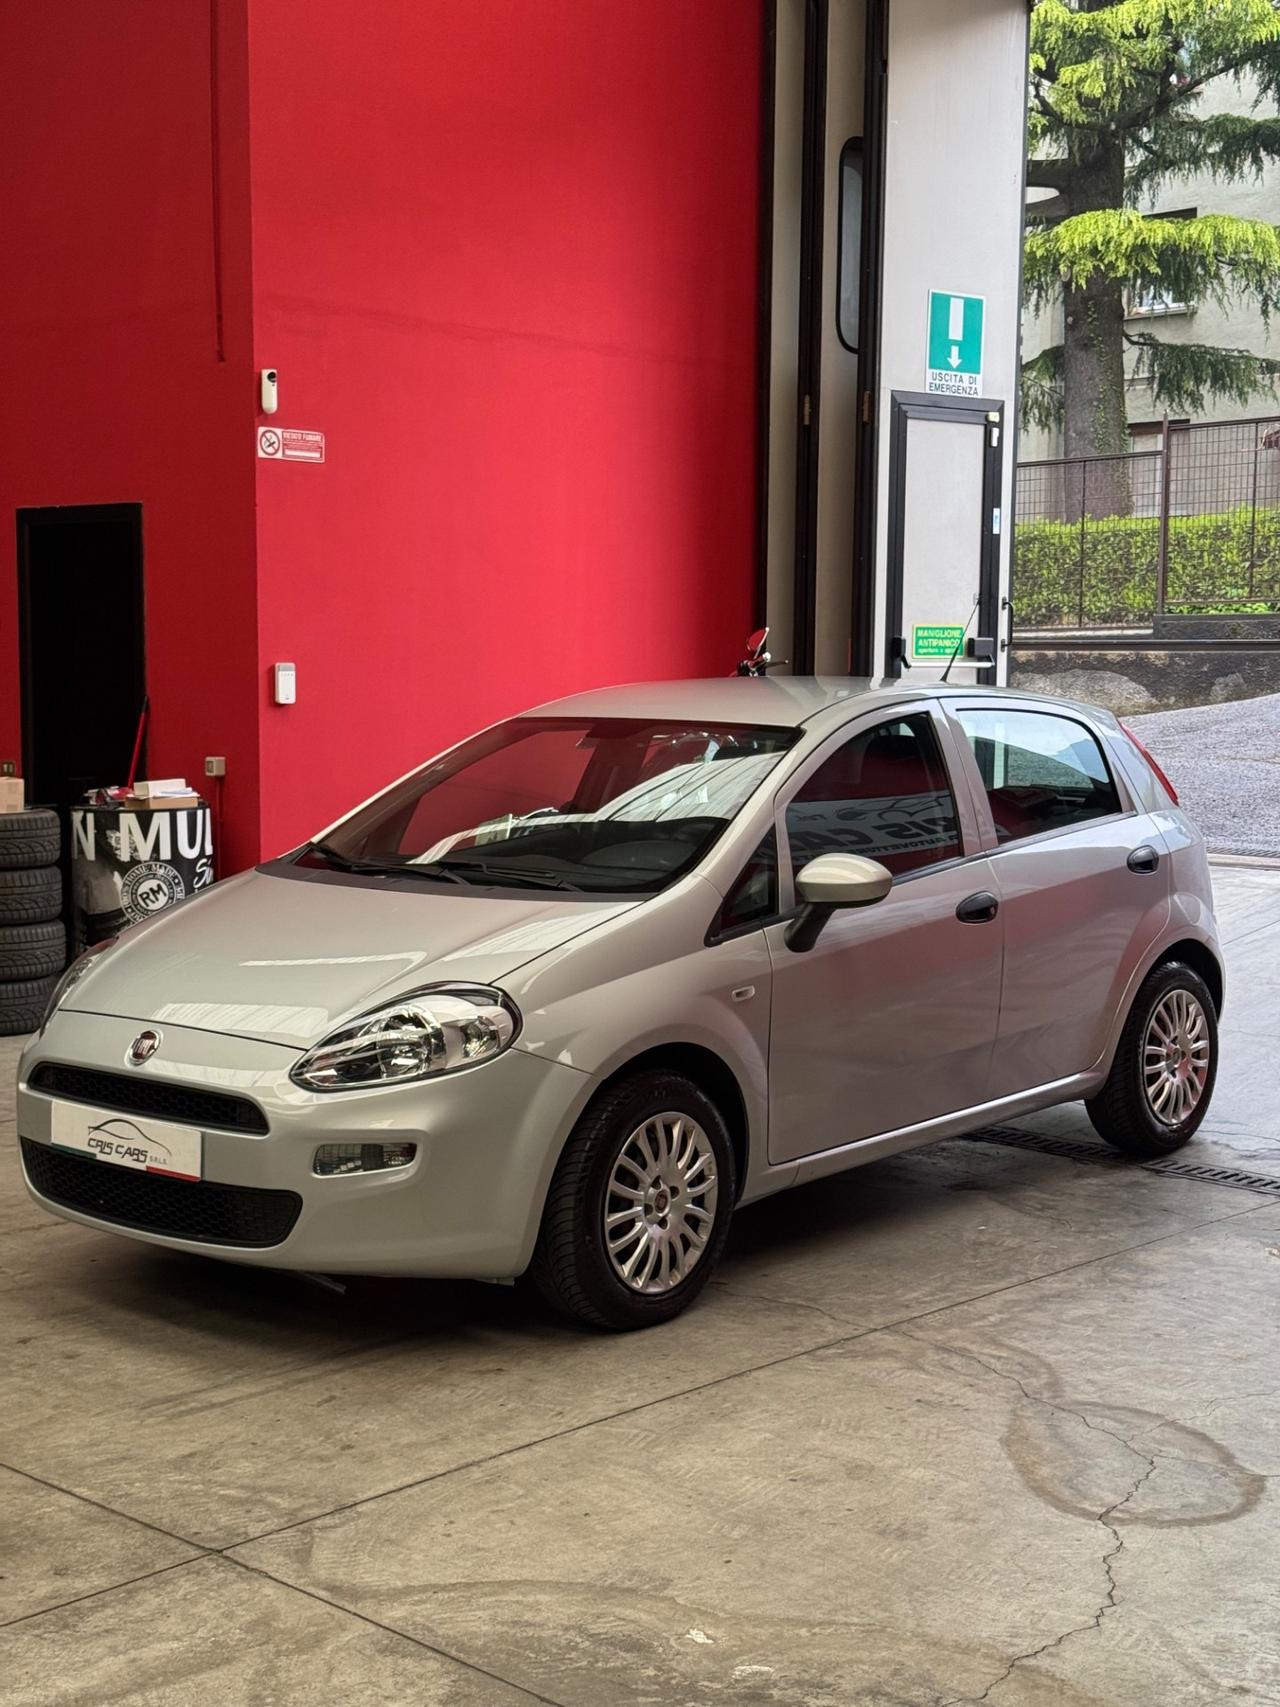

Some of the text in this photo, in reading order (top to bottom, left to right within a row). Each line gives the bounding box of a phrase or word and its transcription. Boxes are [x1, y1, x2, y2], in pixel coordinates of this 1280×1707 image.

[931, 372, 977, 385] USCITA DI
[928, 382, 979, 396] EMERGENZA
[917, 629, 961, 638] MANIGLIONE
[918, 638, 960, 647] ANTIPANICO
[139, 883, 167, 907] RM
[87, 1138, 114, 1155] CRIS
[115, 1144, 149, 1163] CARS
